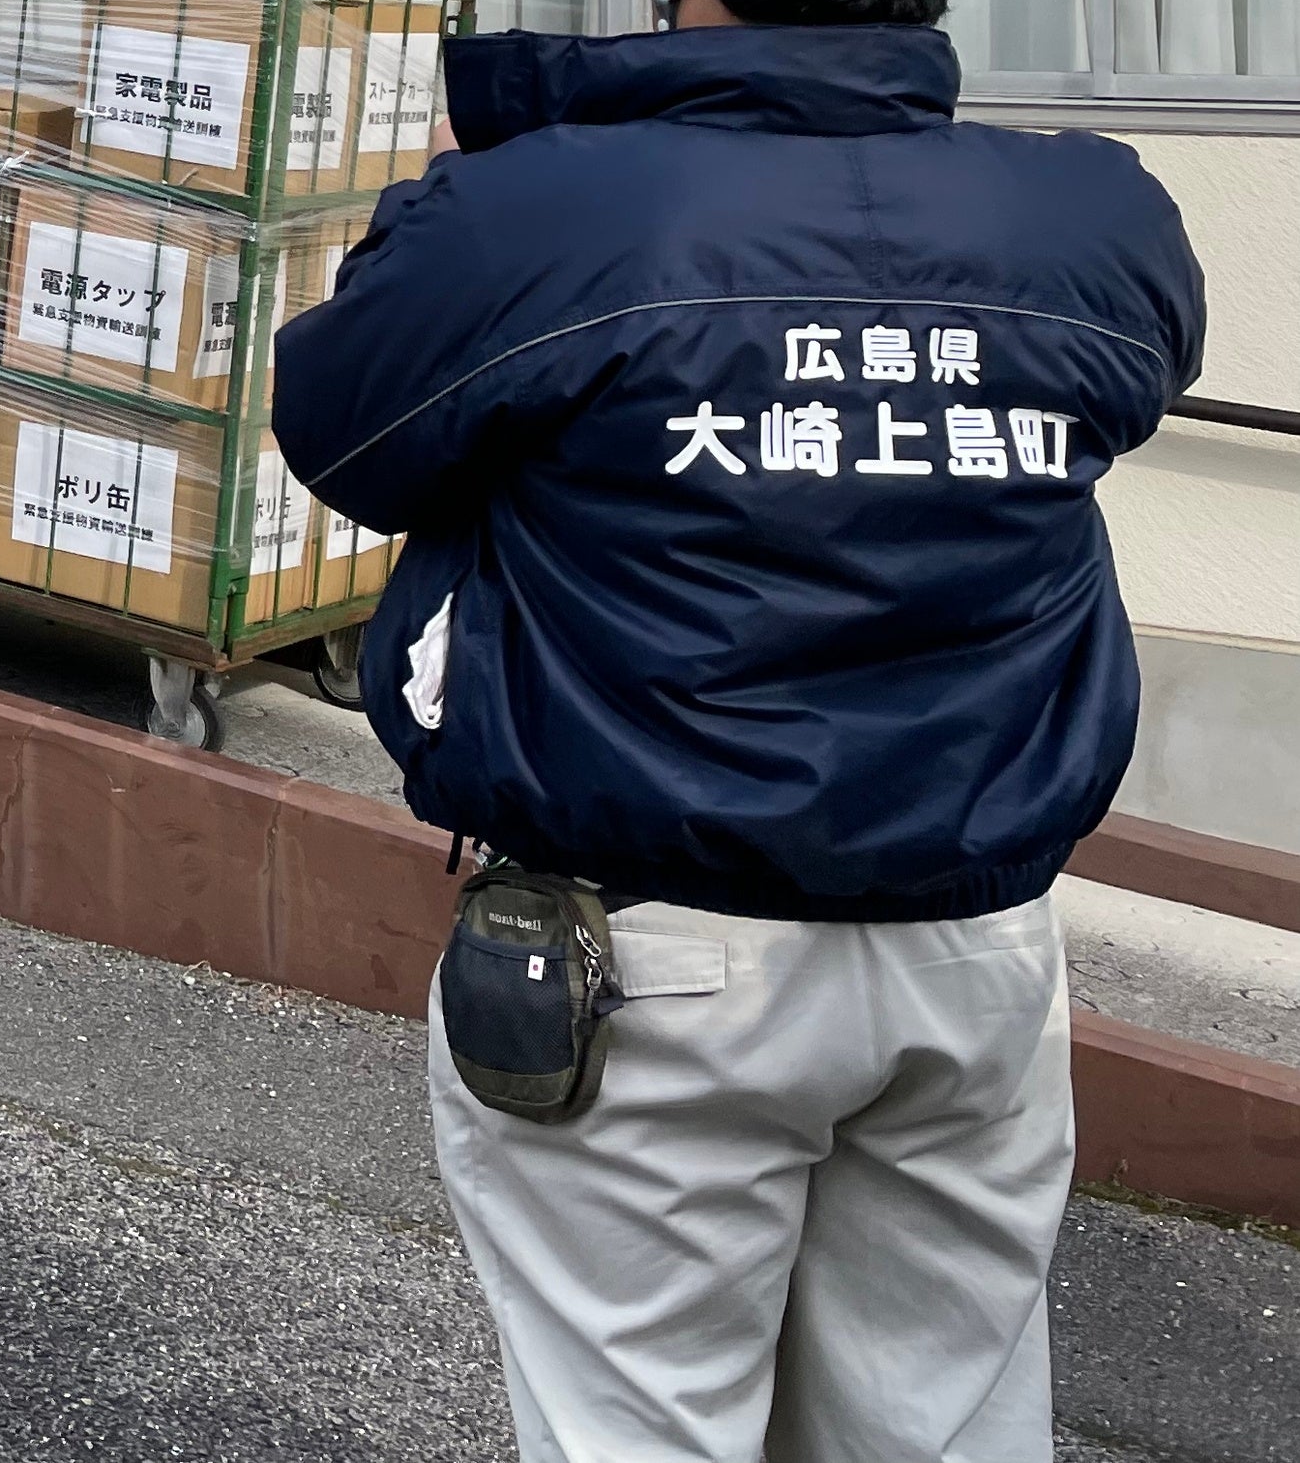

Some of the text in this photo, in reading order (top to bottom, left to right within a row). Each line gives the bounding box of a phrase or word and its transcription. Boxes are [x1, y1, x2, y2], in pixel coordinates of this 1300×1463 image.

[115, 72, 213, 112] 家電製品
[40, 267, 167, 313] 電源タップ
[784, 322, 981, 385] 広島県
[664, 400, 1080, 479] 大崎上島町
[55, 475, 131, 512] ポリ缶
